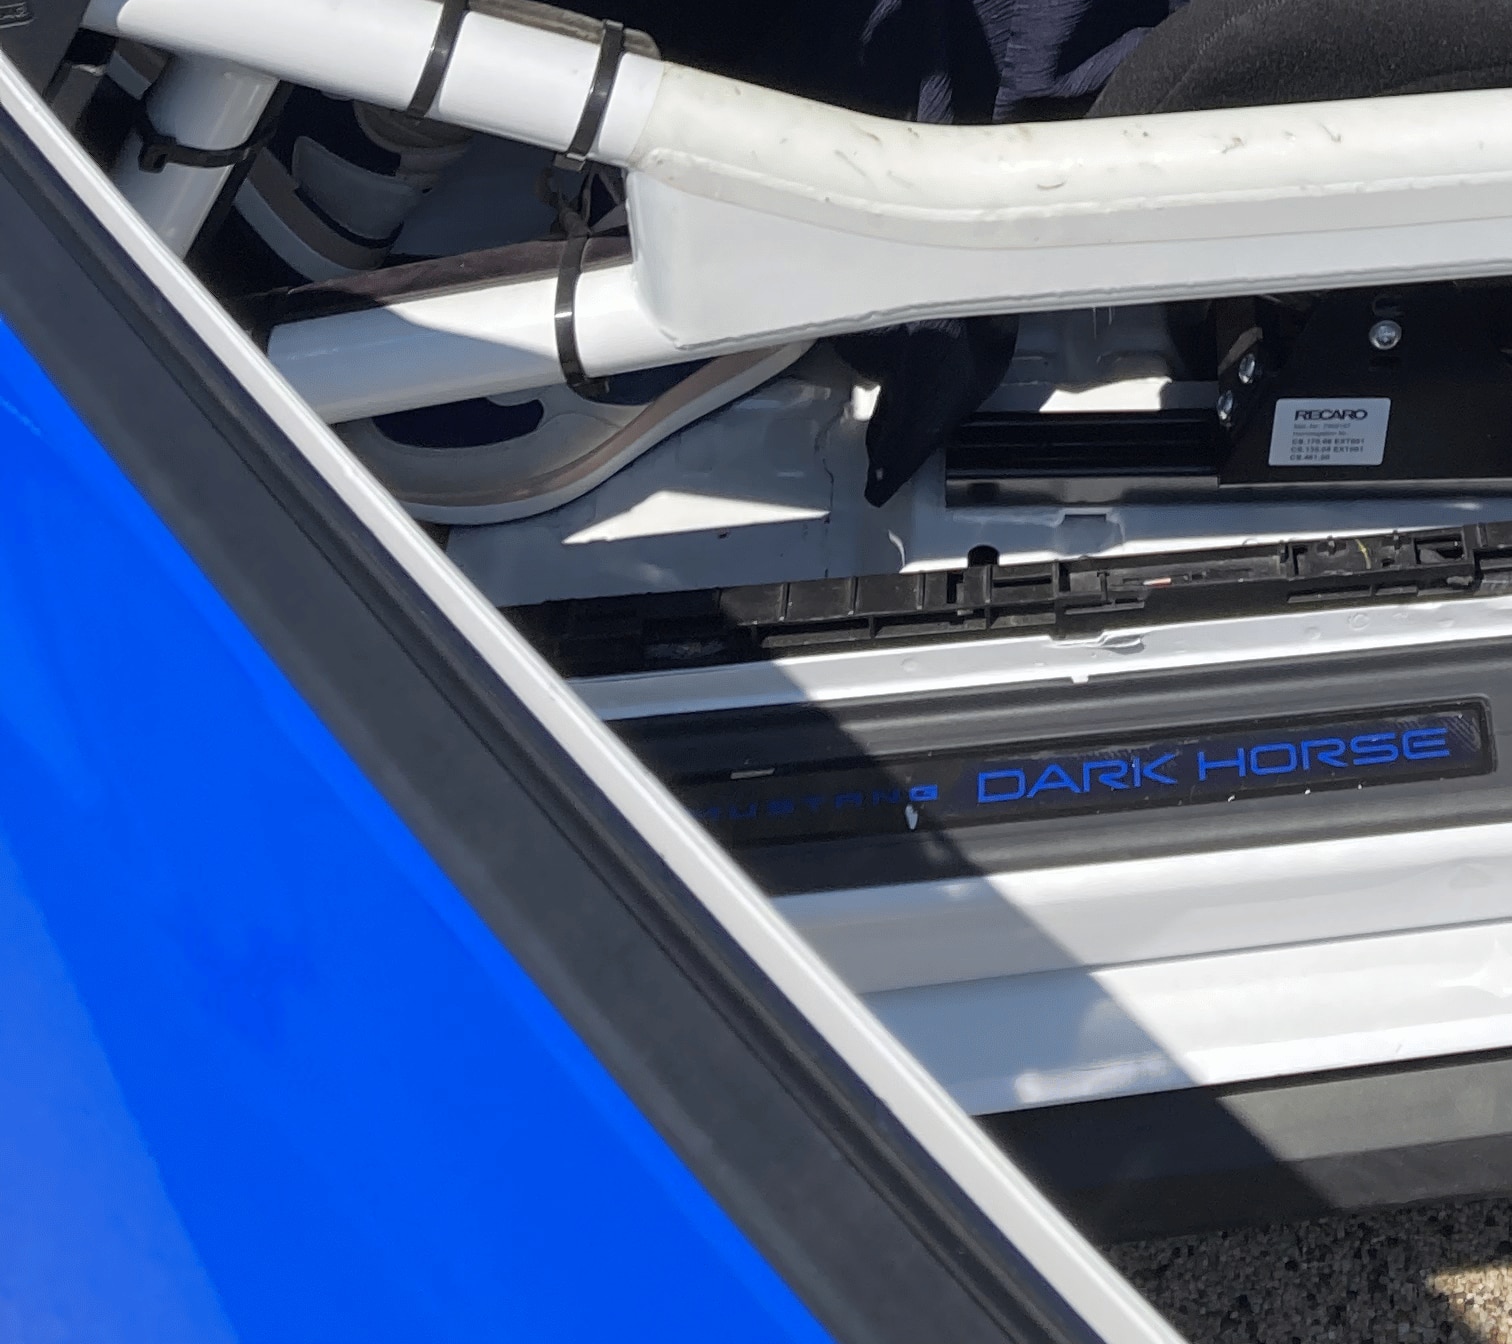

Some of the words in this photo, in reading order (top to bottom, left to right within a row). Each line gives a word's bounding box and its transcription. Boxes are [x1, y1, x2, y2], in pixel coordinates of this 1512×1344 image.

[1294, 409, 1368, 420] RECARO
[975, 751, 1179, 805] DARK
[1197, 728, 1450, 782] HORSE
